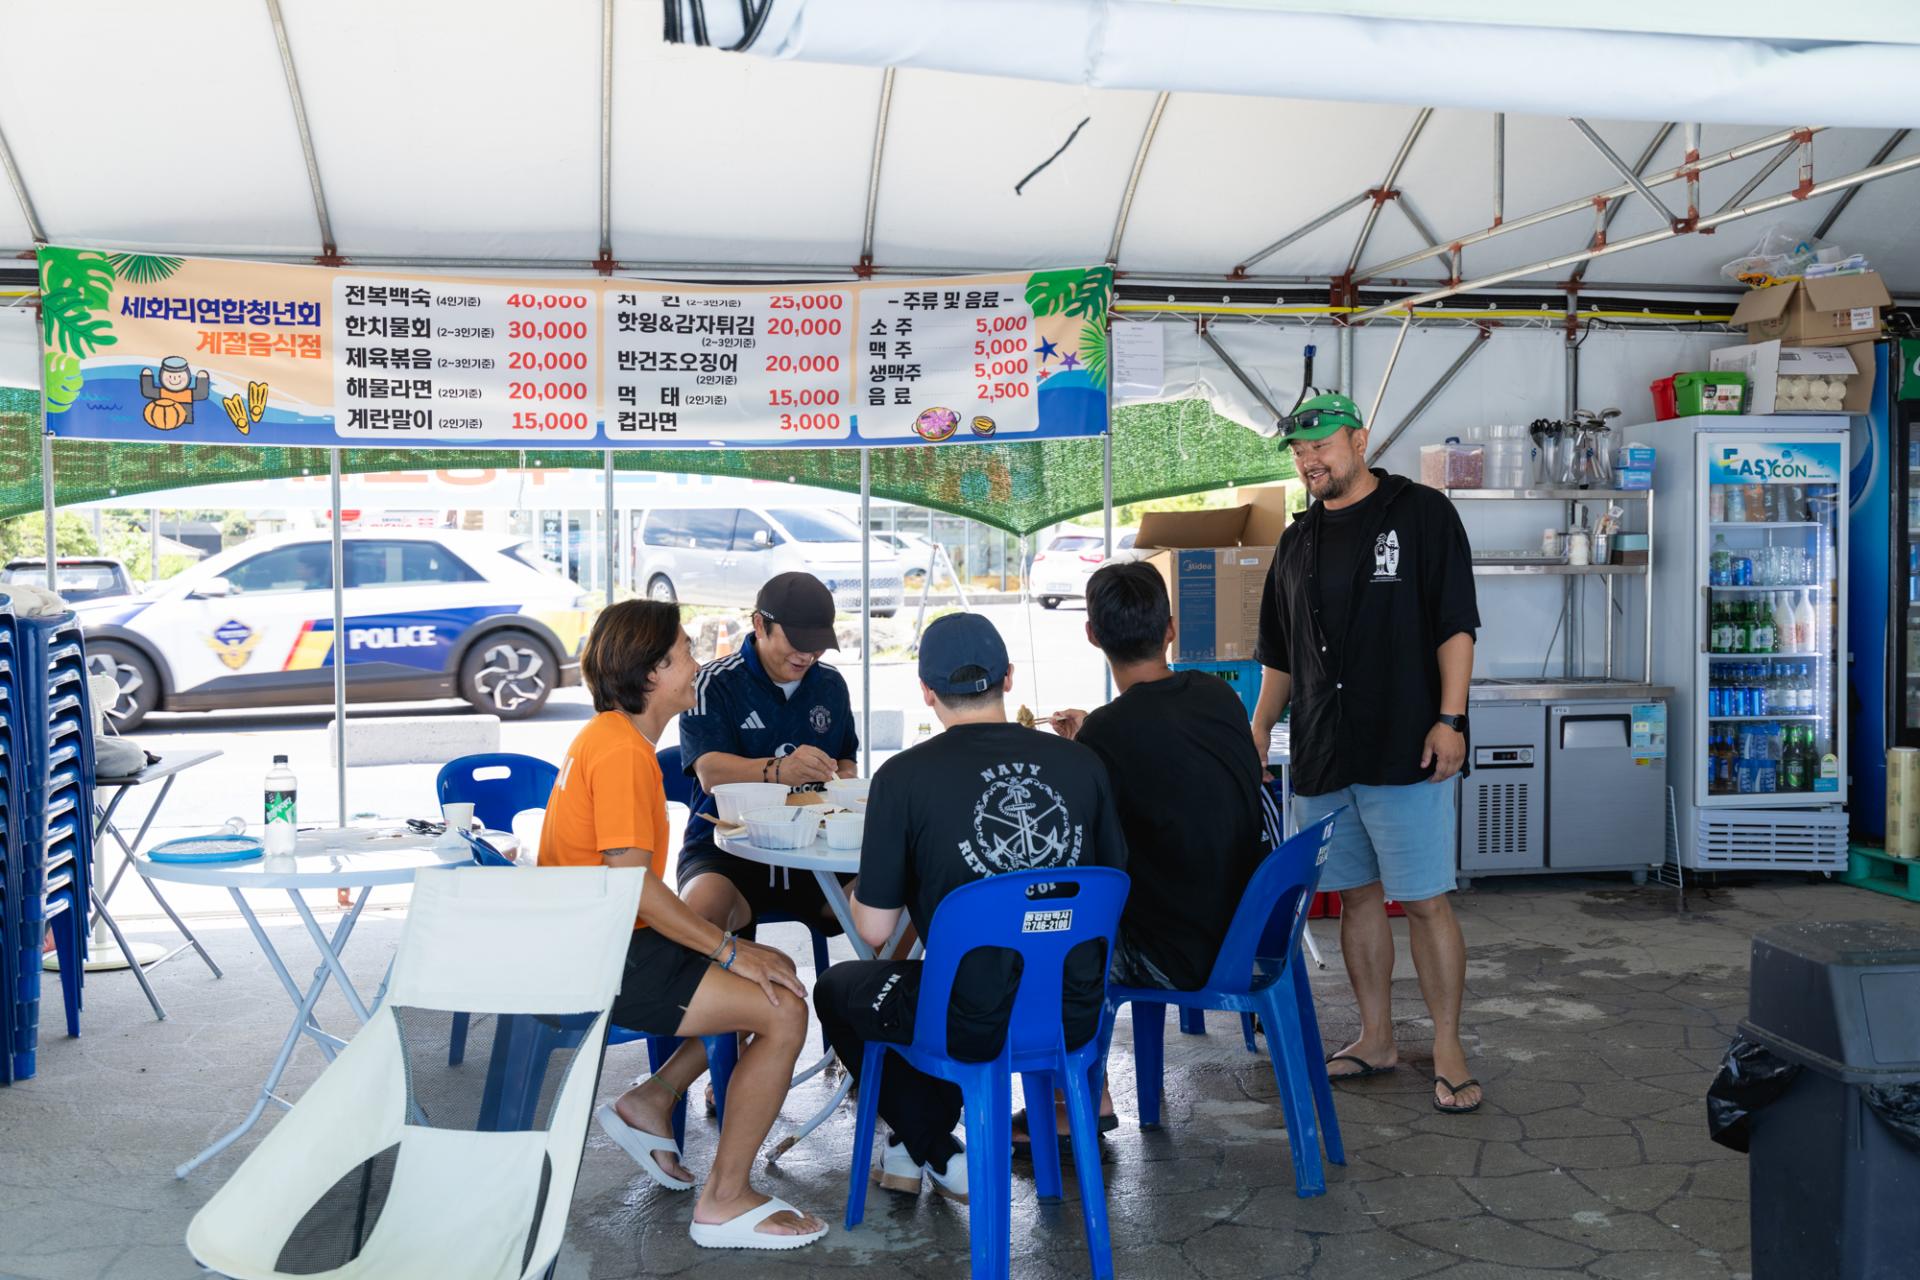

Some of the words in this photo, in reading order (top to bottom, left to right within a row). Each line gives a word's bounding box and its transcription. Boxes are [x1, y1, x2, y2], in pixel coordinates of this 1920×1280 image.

[345, 285, 431, 307] 전복백숙
[436, 295, 481, 307] (4인기준)
[507, 294, 587, 310] 40,000
[769, 295, 843, 311] 25,000
[903, 292, 938, 310] 주류
[944, 292, 960, 310] 및
[965, 291, 999, 309] 음료
[120, 296, 321, 327] 세화리연합청년회
[345, 315, 431, 339] 한치물회
[437, 327, 494, 339] (2~3인기준)
[508, 321, 587, 341] 30,000
[618, 312, 755, 335] 핫윙&감자튀김
[767, 318, 842, 337] 20,000
[976, 316, 1027, 336] 5,000
[196, 330, 322, 359] 계절음식점
[702, 338, 756, 349] (2~3인기준)
[974, 338, 1028, 359] 5,000
[345, 347, 432, 369] 제육볶음
[437, 358, 495, 369] (2~3인기준)
[508, 352, 587, 371] 20,000
[618, 351, 738, 373] 반건조오징어
[765, 355, 840, 373] 20,000
[869, 364, 921, 382] 생맥주
[974, 358, 1028, 380] 5,000
[346, 377, 432, 399] 해물라면
[438, 388, 482, 399] (2인기준)
[509, 382, 587, 402] 20,000
[696, 375, 738, 386] (2인기준)
[685, 395, 727, 406] (2인기준)
[768, 389, 840, 407] 15,000
[977, 382, 1029, 403] 2,500
[347, 409, 433, 430] 계란말이
[439, 418, 483, 430] (2인기준)
[512, 412, 588, 433] 15,000
[618, 411, 677, 432] 컵라면
[780, 413, 840, 432] 3,000
[349, 625, 437, 650] POLICE
[980, 763, 1041, 782] NAVY
